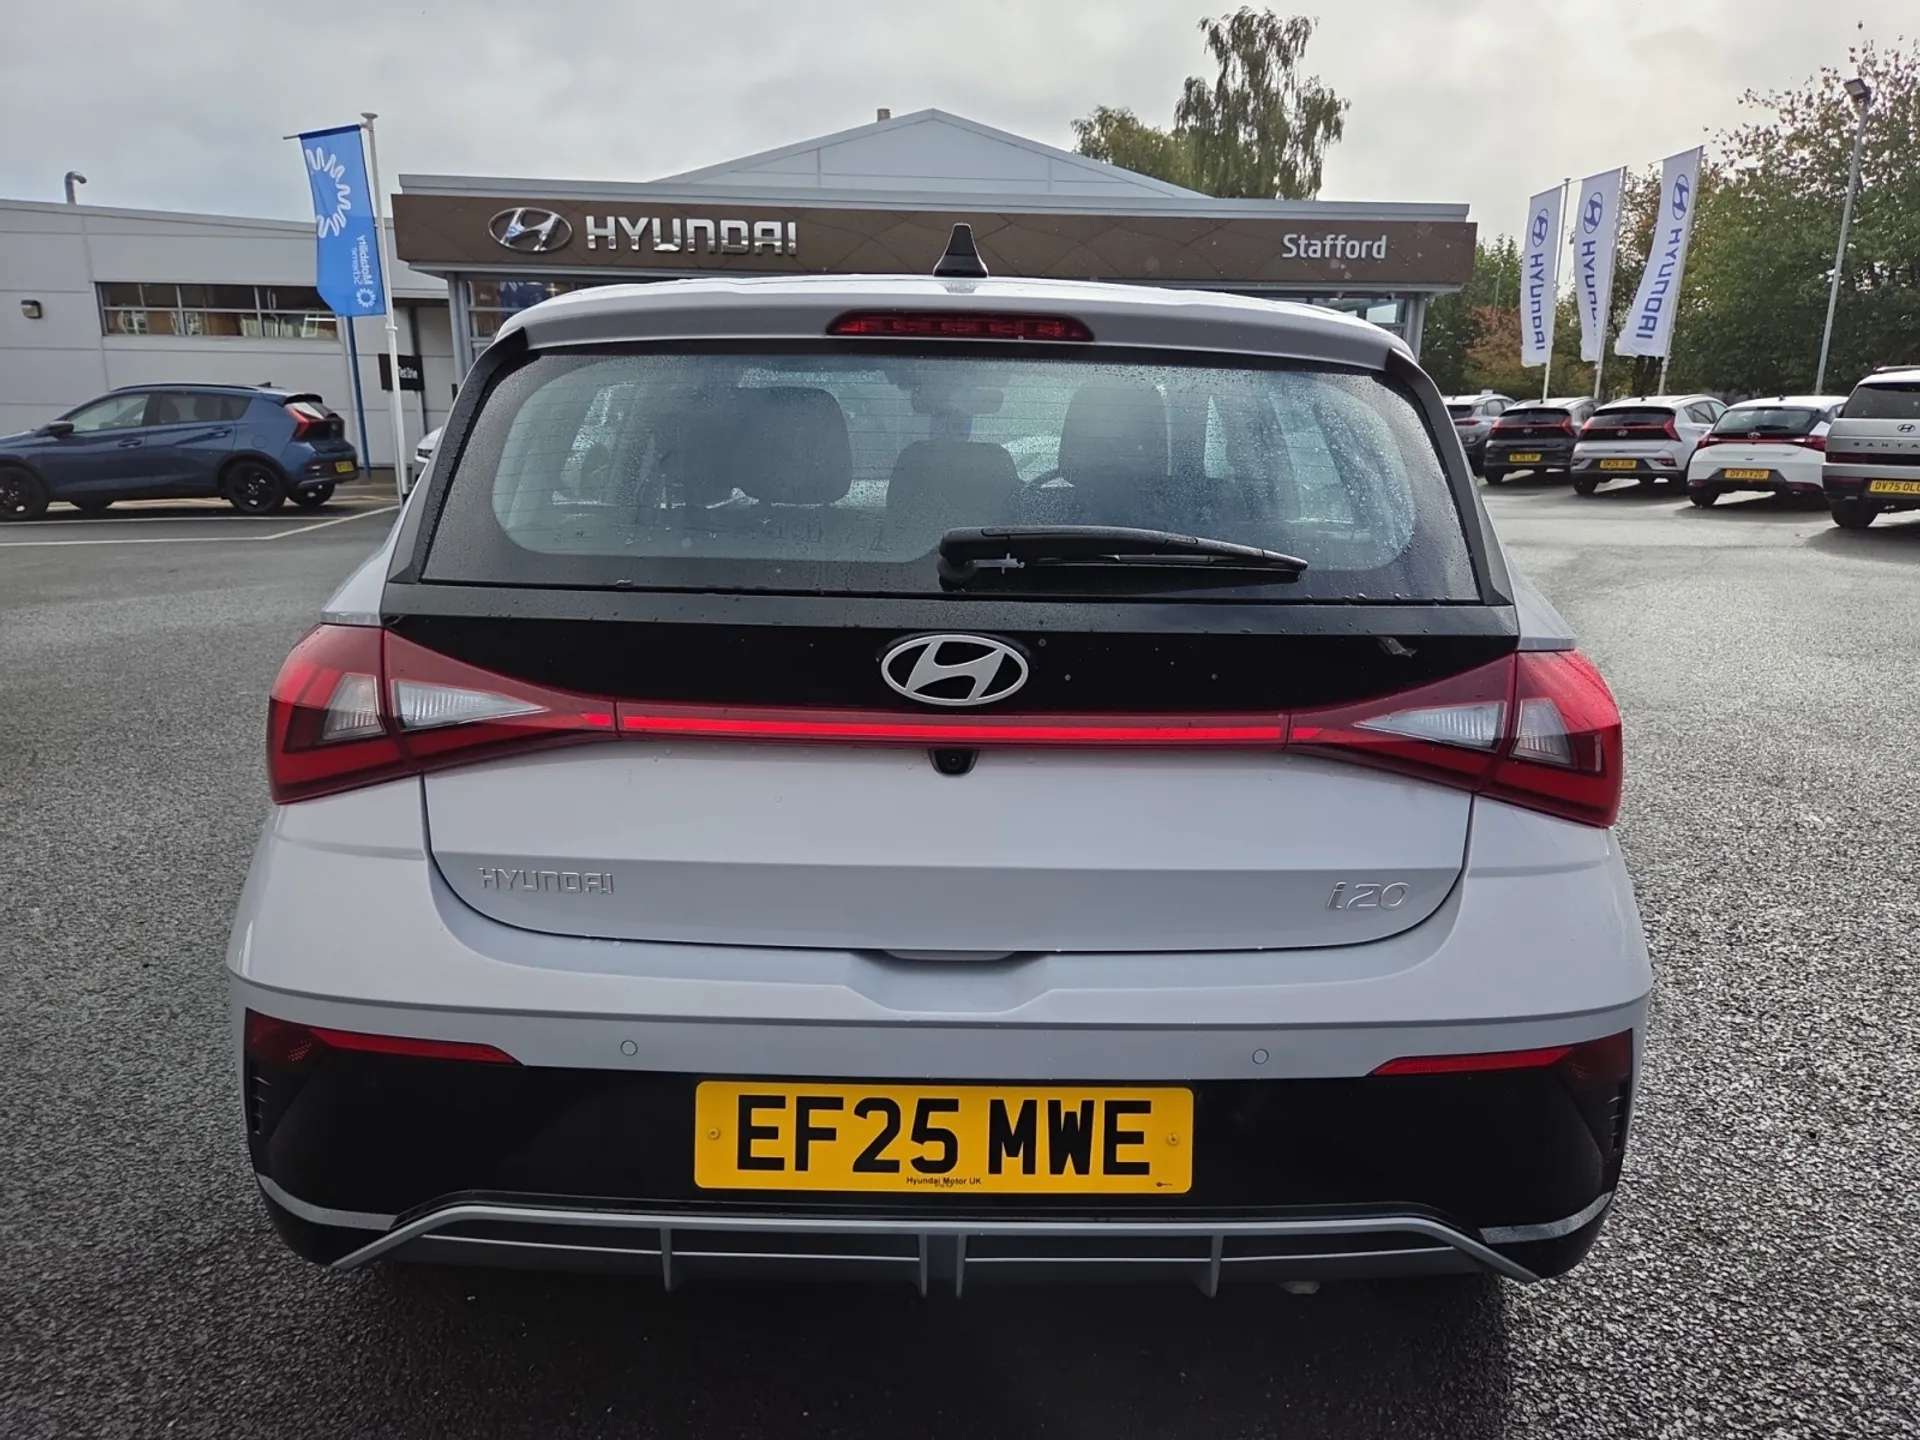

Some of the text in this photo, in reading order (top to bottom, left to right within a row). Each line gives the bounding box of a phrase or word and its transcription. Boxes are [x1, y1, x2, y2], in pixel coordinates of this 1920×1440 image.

[585, 215, 797, 256] HYUNDAI
[1282, 234, 1387, 259] Stafford
[1635, 228, 1682, 339] HYUNDAI
[1529, 253, 1546, 350] HYUNDAI
[479, 867, 614, 895] HYUNDAI
[1326, 881, 1409, 910] i20
[737, 1094, 1152, 1175] EF25 MWE
[906, 1176, 982, 1185] Hyundai Motor UK
